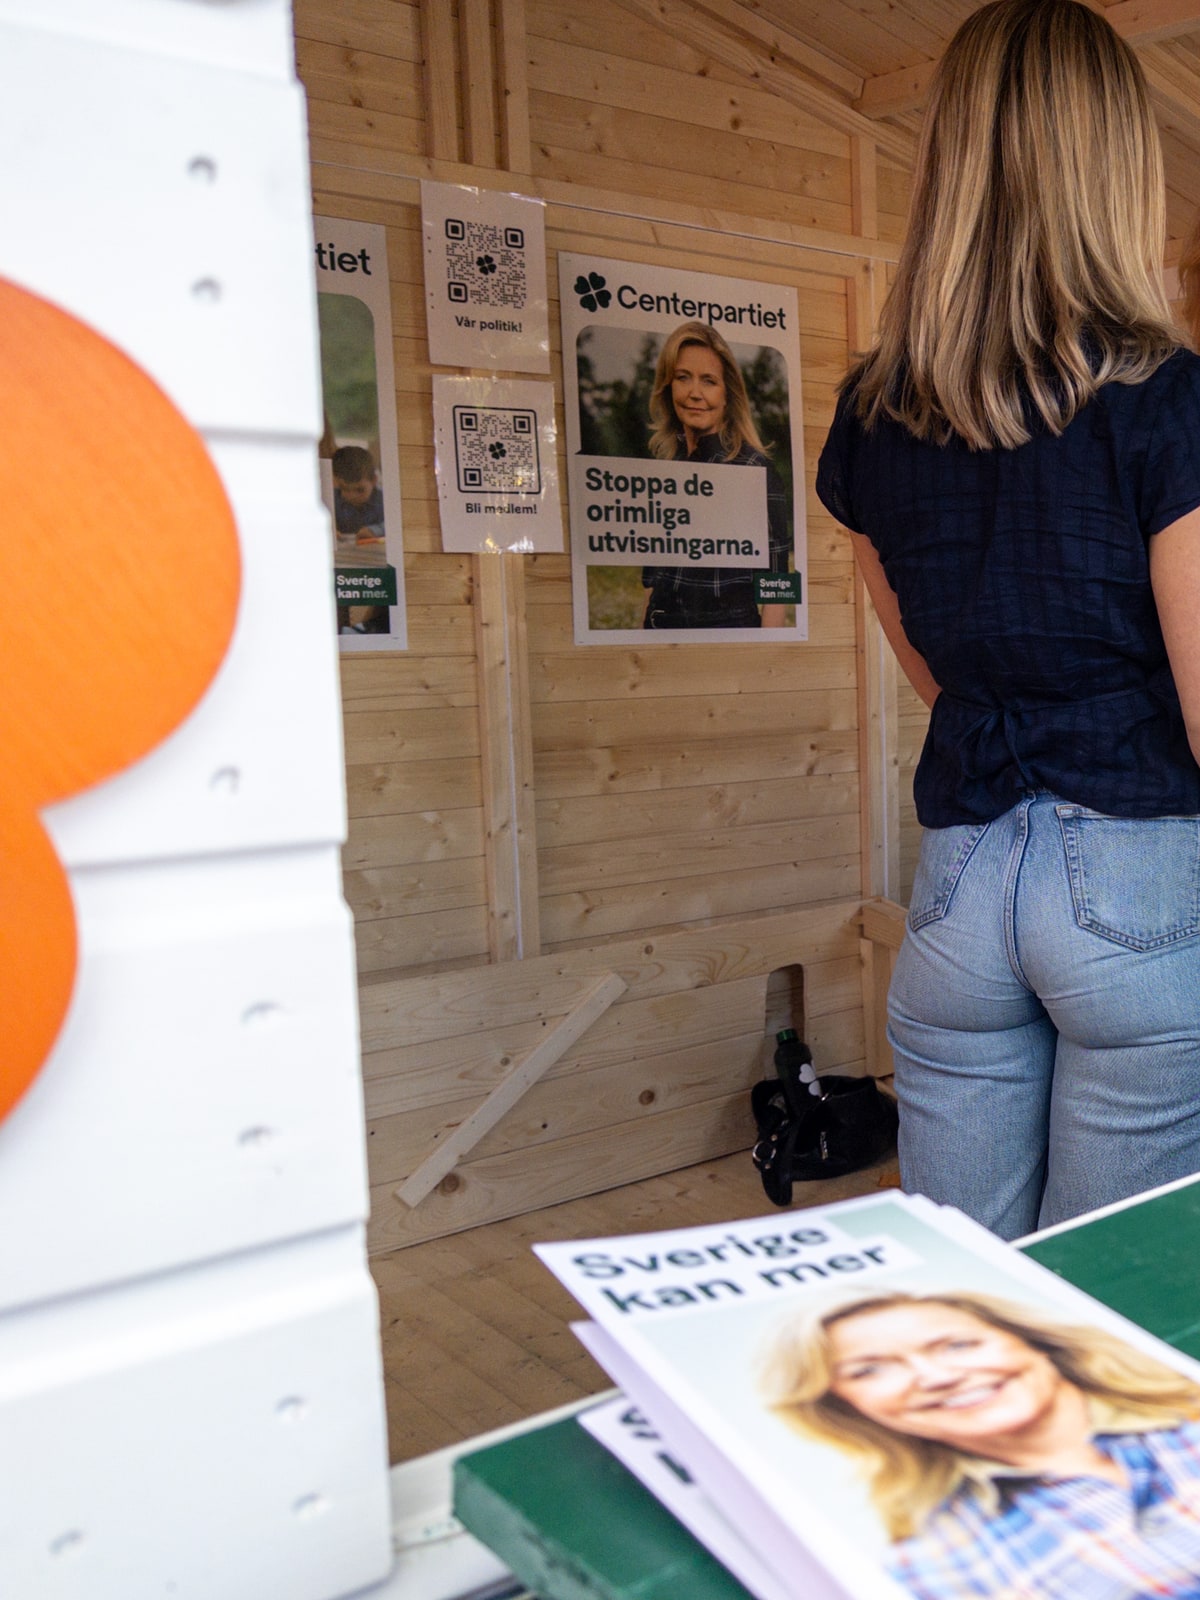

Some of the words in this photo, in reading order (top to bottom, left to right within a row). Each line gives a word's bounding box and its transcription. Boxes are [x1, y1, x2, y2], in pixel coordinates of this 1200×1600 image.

[616, 284, 787, 330] Centerpartiet
[455, 315, 477, 328] Vår
[479, 319, 523, 333] politik!
[585, 467, 678, 499] Stoppa
[683, 473, 714, 497] de
[465, 503, 482, 514] Bli
[484, 503, 538, 515] medlem!
[586, 499, 691, 530] orimliga
[588, 529, 761, 561] utvisningarna.
[336, 574, 382, 587] Sverige
[759, 578, 792, 590] Sverige
[337, 588, 361, 599] kan
[362, 589, 389, 599] mer.
[759, 588, 776, 598] kan
[776, 590, 796, 599] mer.
[571, 1226, 830, 1280] Sverige
[598, 1277, 745, 1315] kan
[757, 1243, 889, 1289] mer
